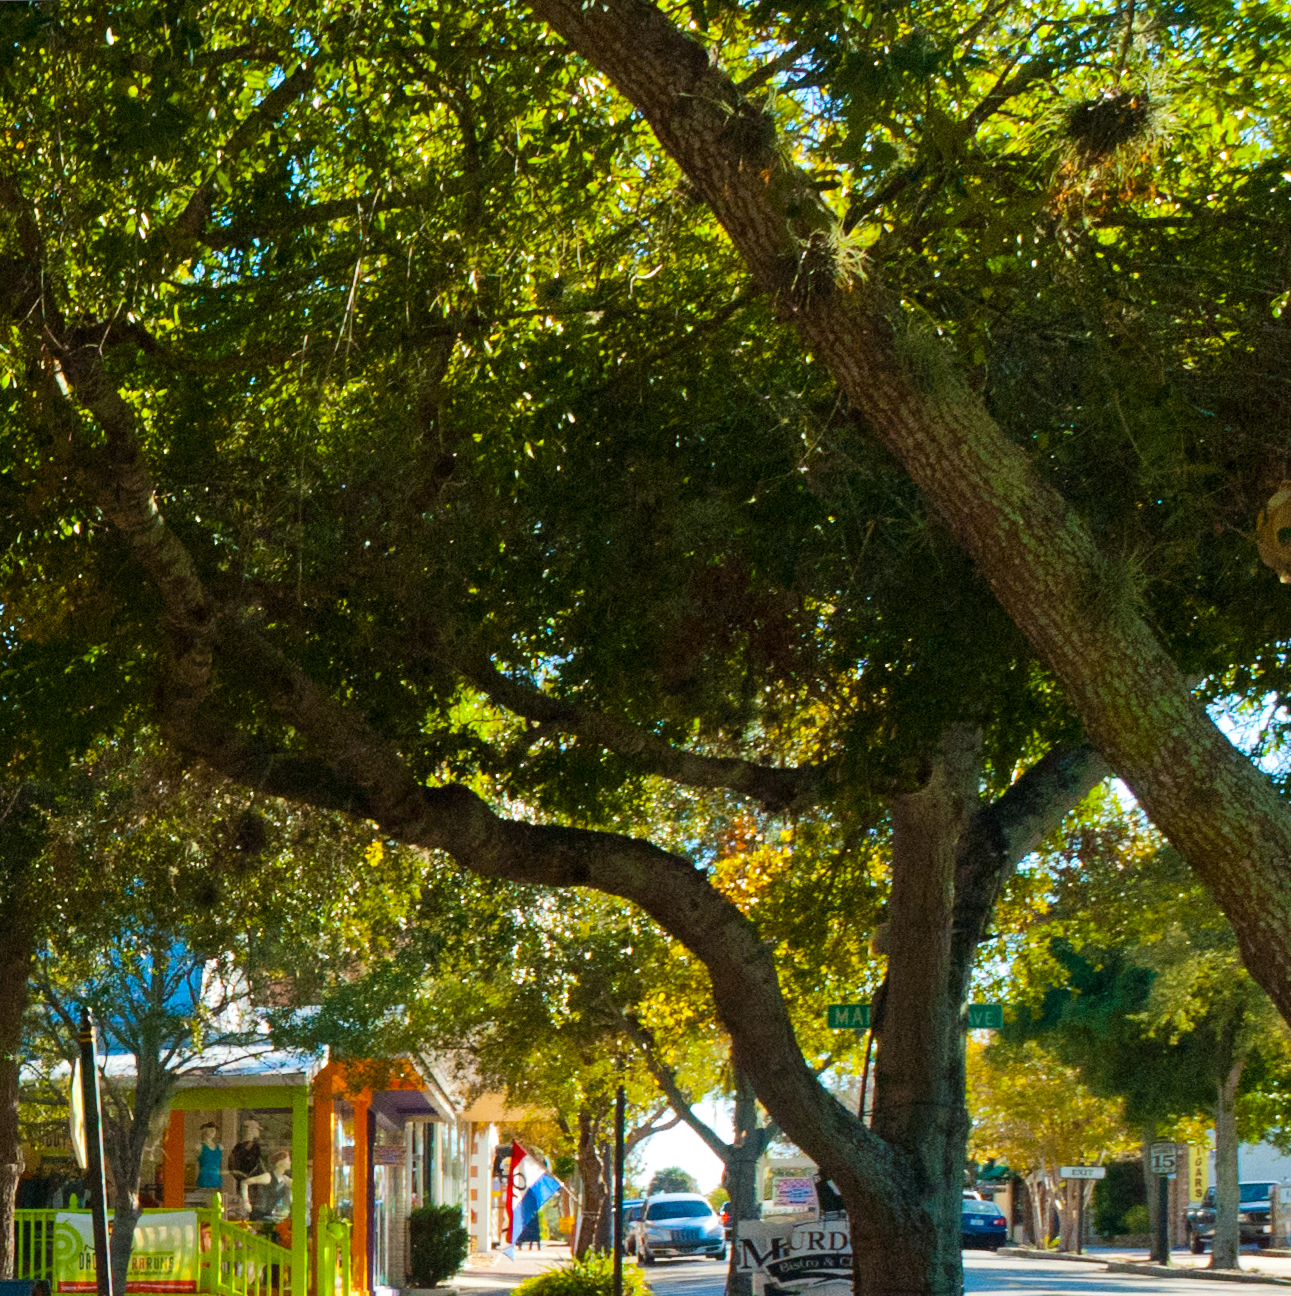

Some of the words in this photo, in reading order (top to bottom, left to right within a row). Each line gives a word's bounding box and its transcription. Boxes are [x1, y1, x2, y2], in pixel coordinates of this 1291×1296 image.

[1153, 1154, 1176, 1168] 15
[1071, 1169, 1094, 1177] EXIT
[1195, 1146, 1203, 1198] IGARS
[779, 1258, 819, 1273] Bistro
[823, 1256, 835, 1267] &
